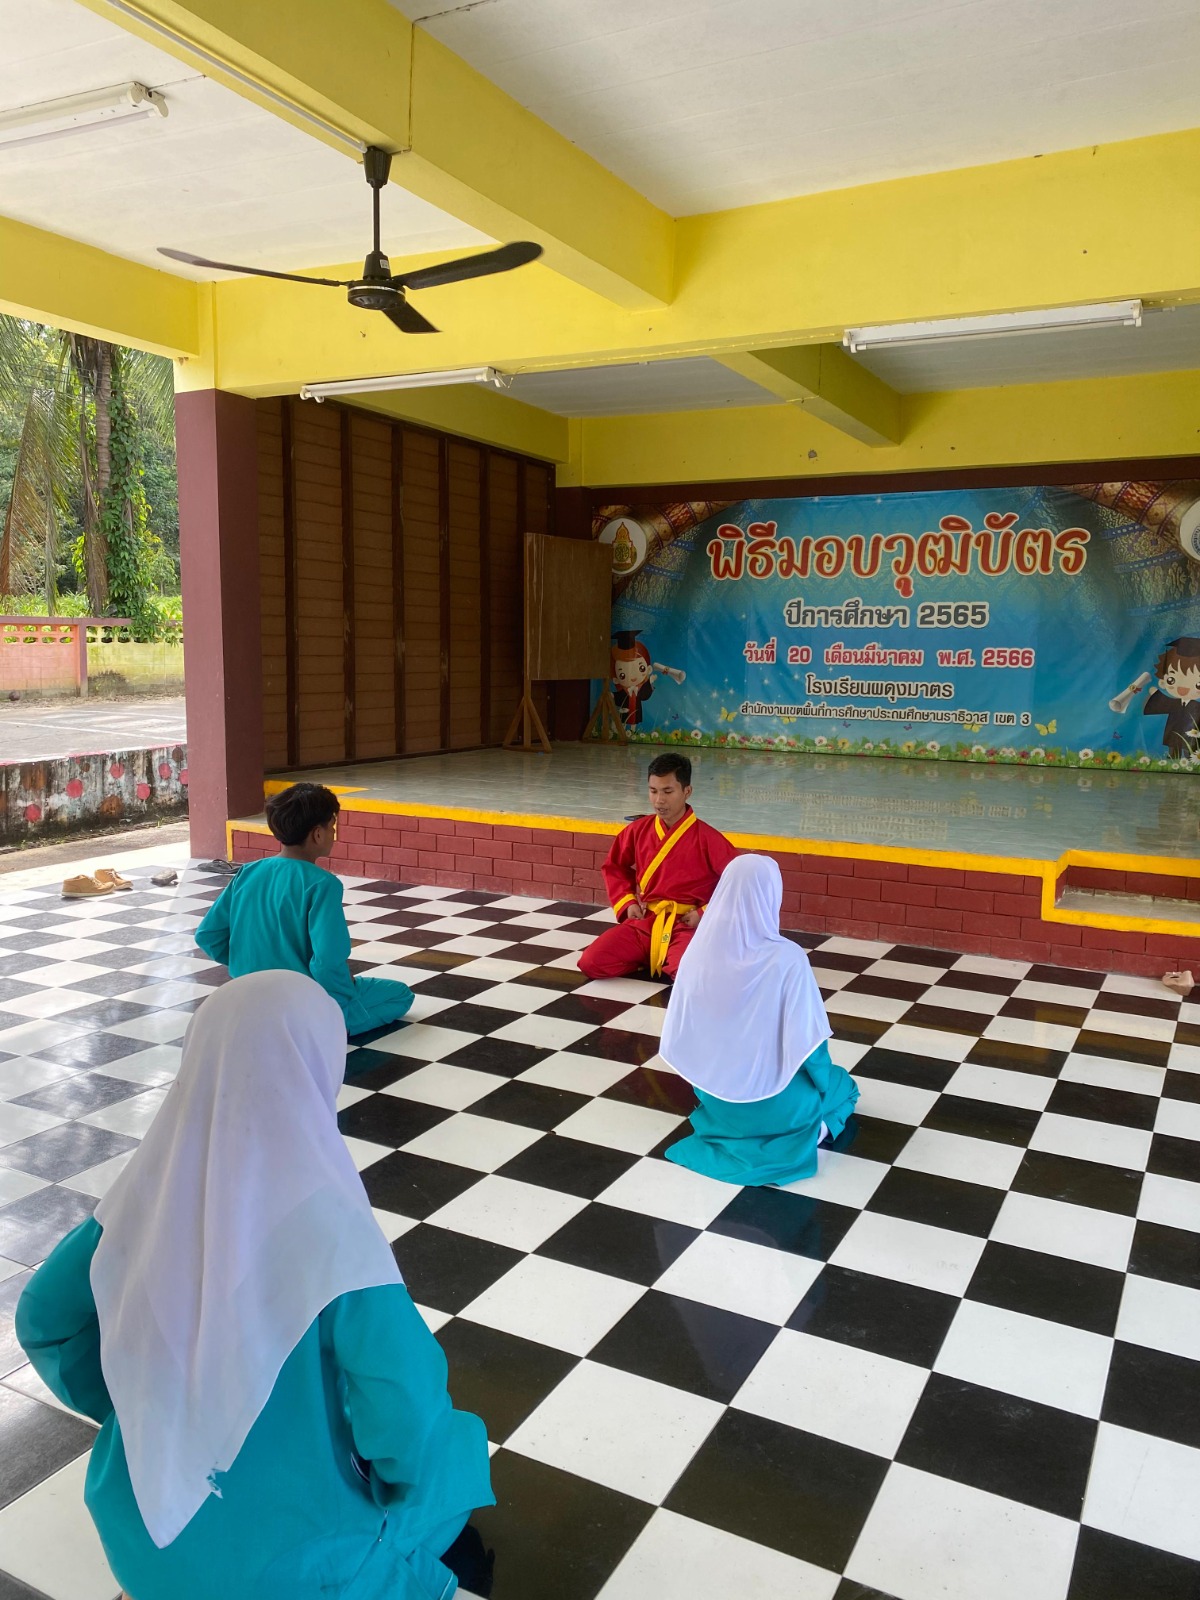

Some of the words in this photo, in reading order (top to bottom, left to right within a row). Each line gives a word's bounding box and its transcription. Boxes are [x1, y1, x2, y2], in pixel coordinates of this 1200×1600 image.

[707, 513, 1091, 597] พิธีมอบวุฒิบัตร
[784, 599, 909, 627] ปีการศึกษา
[918, 603, 988, 627] 2565
[744, 638, 776, 662] วันที่
[788, 646, 812, 663] 20
[824, 643, 923, 666] เดือนมีนาคม
[937, 649, 975, 666] พ.ศ.
[982, 648, 1034, 667] 2566
[740, 701, 988, 723] สำนักงานเขตพื้นที่การศึกษาประถมศึกษานราธิวาส
[994, 713, 1016, 724] เขต
[1021, 714, 1031, 725] 3
